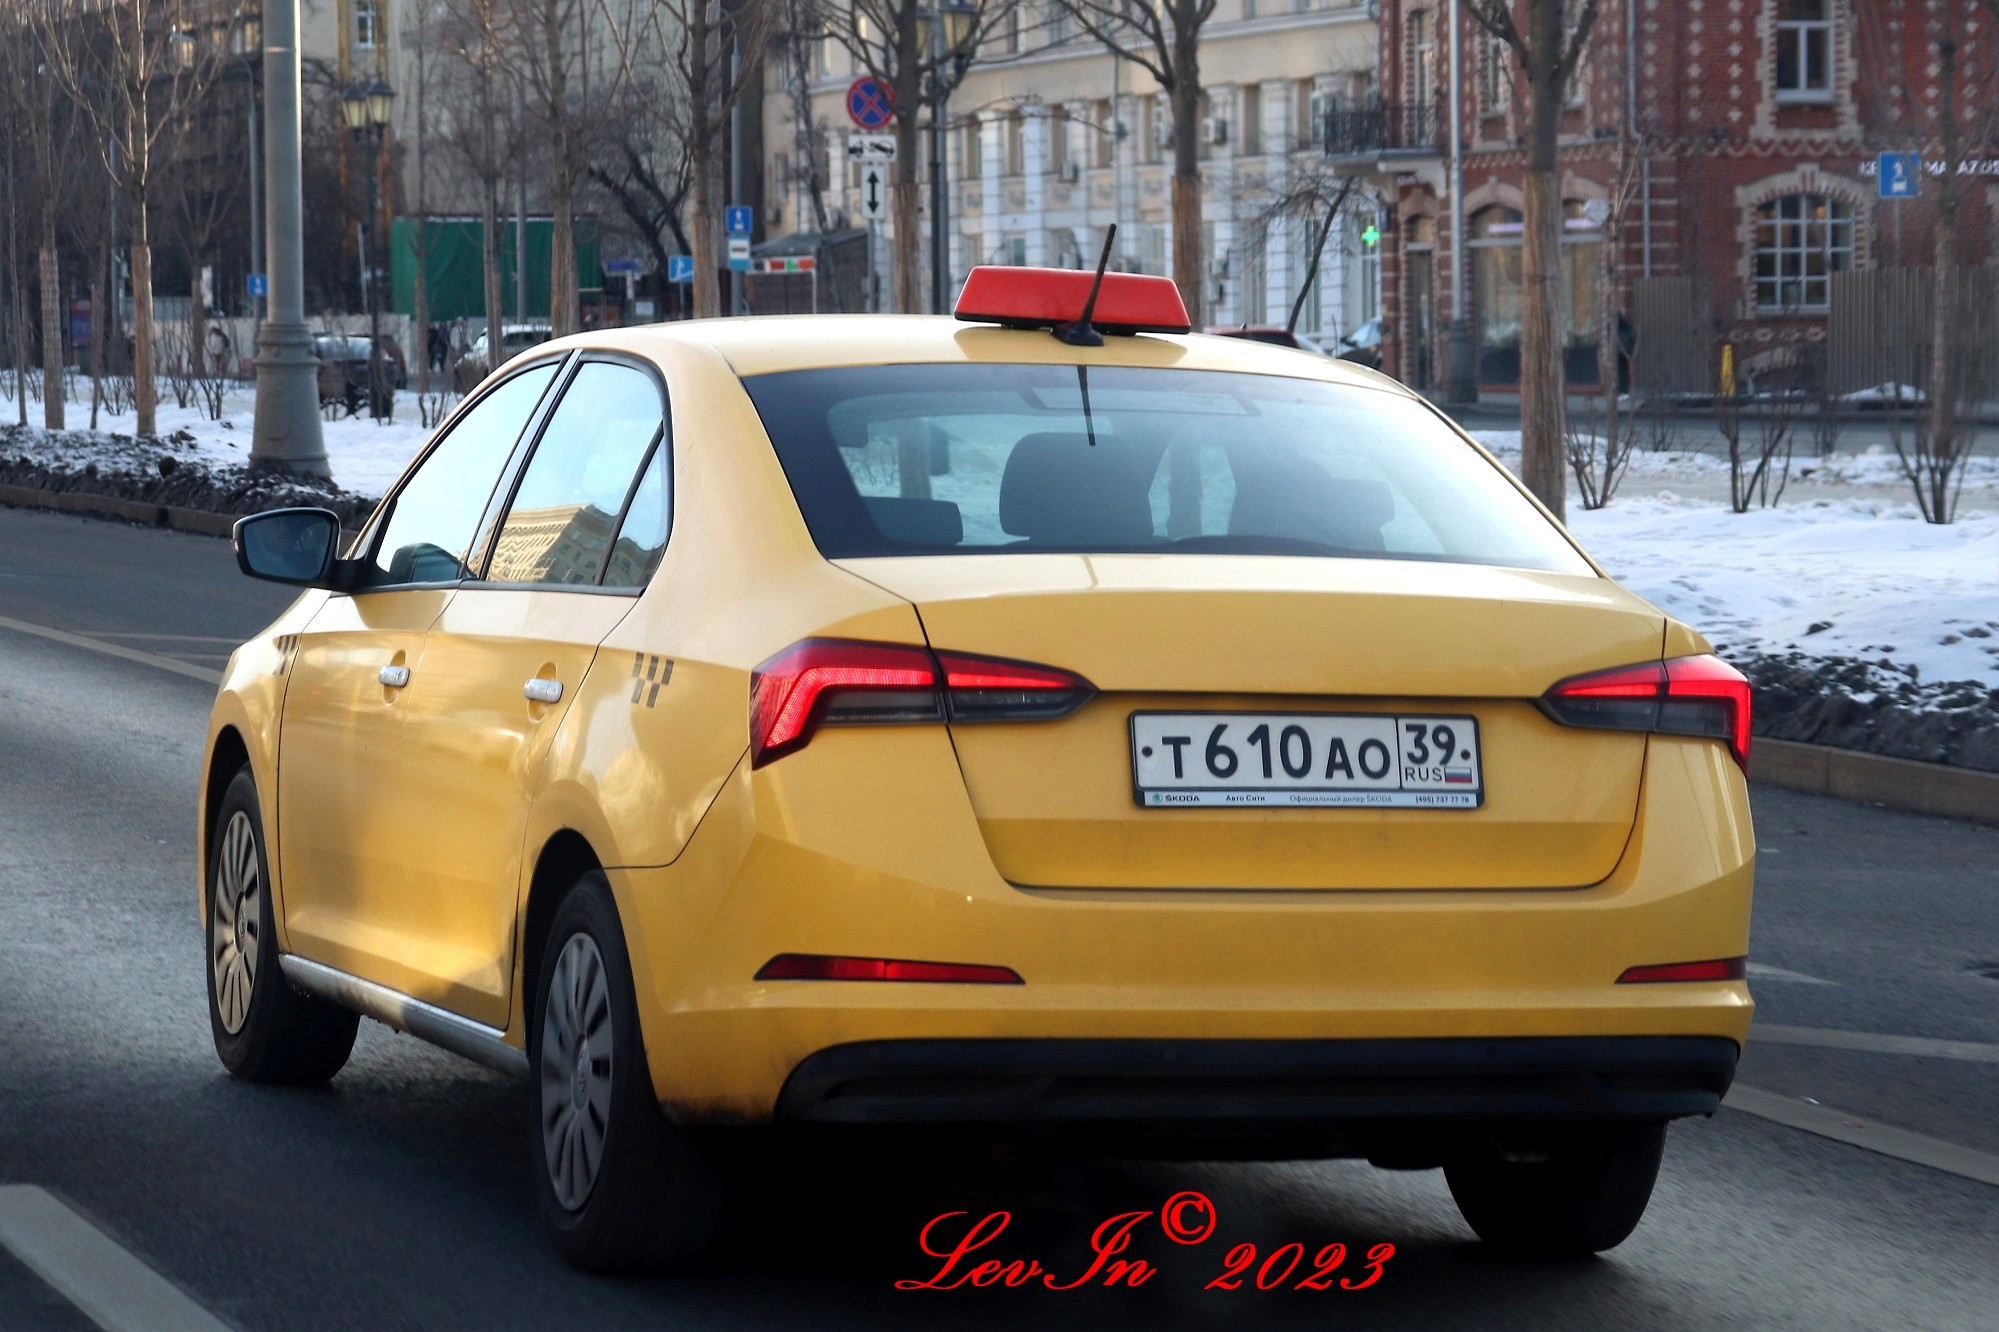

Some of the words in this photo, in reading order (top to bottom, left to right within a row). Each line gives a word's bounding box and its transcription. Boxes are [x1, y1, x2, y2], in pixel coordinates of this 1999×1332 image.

[1404, 767, 1443, 782] RUS
[1226, 794, 1245, 803] Авто
[1247, 794, 1266, 803] Сити
[1415, 795, 1434, 804] (495)
